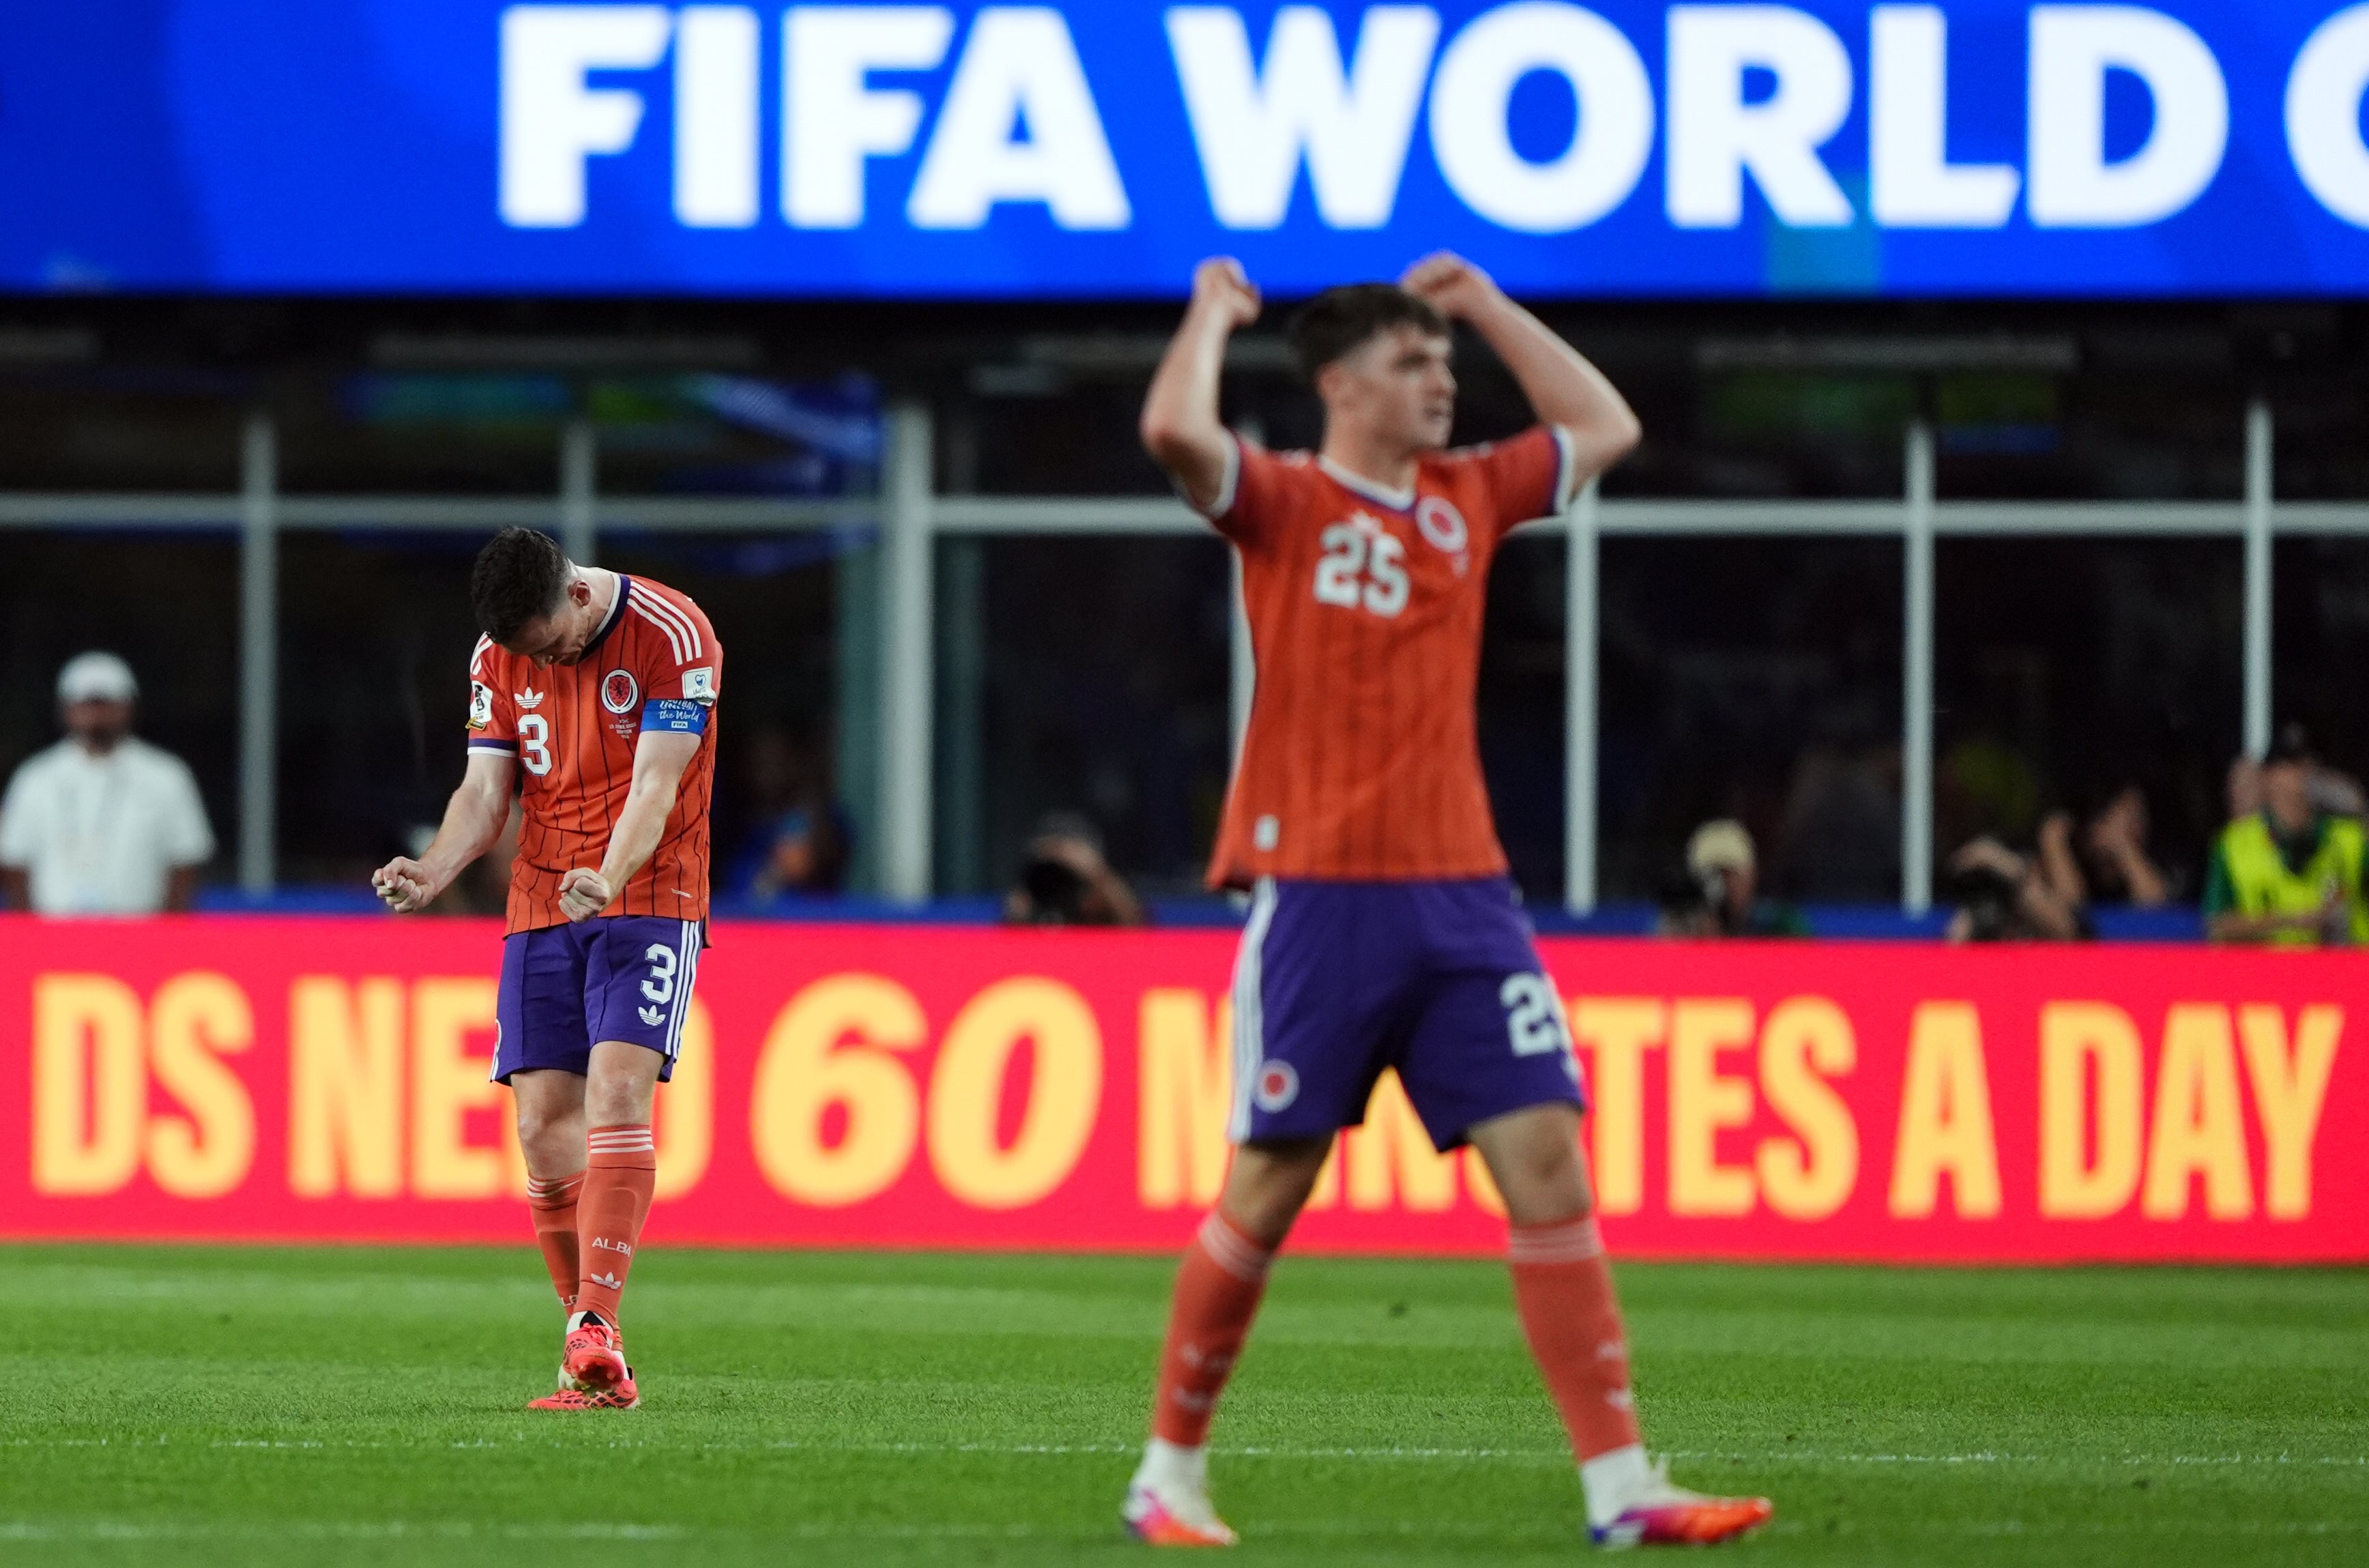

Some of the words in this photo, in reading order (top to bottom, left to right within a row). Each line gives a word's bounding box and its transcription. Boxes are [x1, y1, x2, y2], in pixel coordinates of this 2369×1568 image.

[498, 4, 1133, 229] FIFA
[1164, 1, 2229, 232] WORLD
[1314, 521, 1410, 618] 25
[518, 714, 553, 776] 3
[657, 710, 675, 719] the
[675, 710, 700, 723] World
[640, 943, 677, 1004] 3
[31, 970, 257, 1198] DS
[751, 970, 1104, 1210] 60
[1887, 999, 2002, 1220] A
[2037, 999, 2346, 1222] DAY
